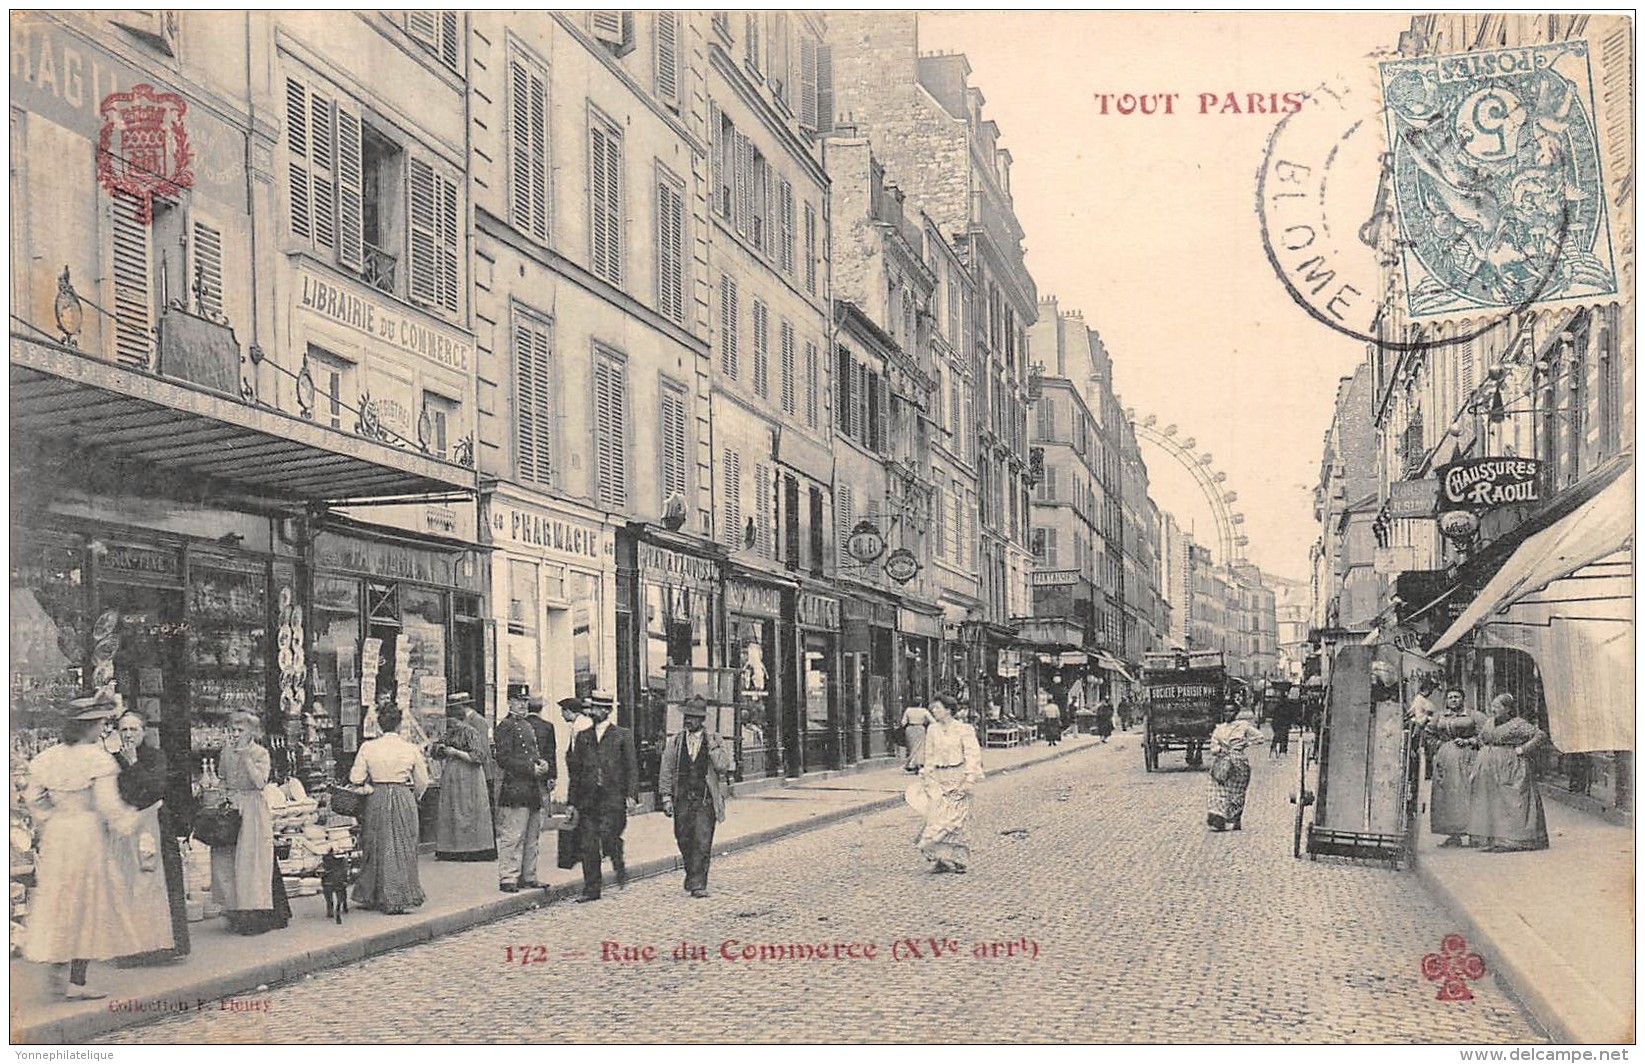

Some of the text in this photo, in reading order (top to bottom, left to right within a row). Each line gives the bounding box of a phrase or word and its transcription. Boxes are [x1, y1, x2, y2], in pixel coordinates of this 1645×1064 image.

[1441, 51, 1530, 80] POSTES
[1472, 93, 1508, 156] 5
[302, 276, 468, 370] LIBRAIRIE DU COMMERCE
[1445, 460, 1537, 503] CHAUSSURES
[1467, 480, 1539, 505] RAOUL
[511, 510, 597, 557] PHARMACIE
